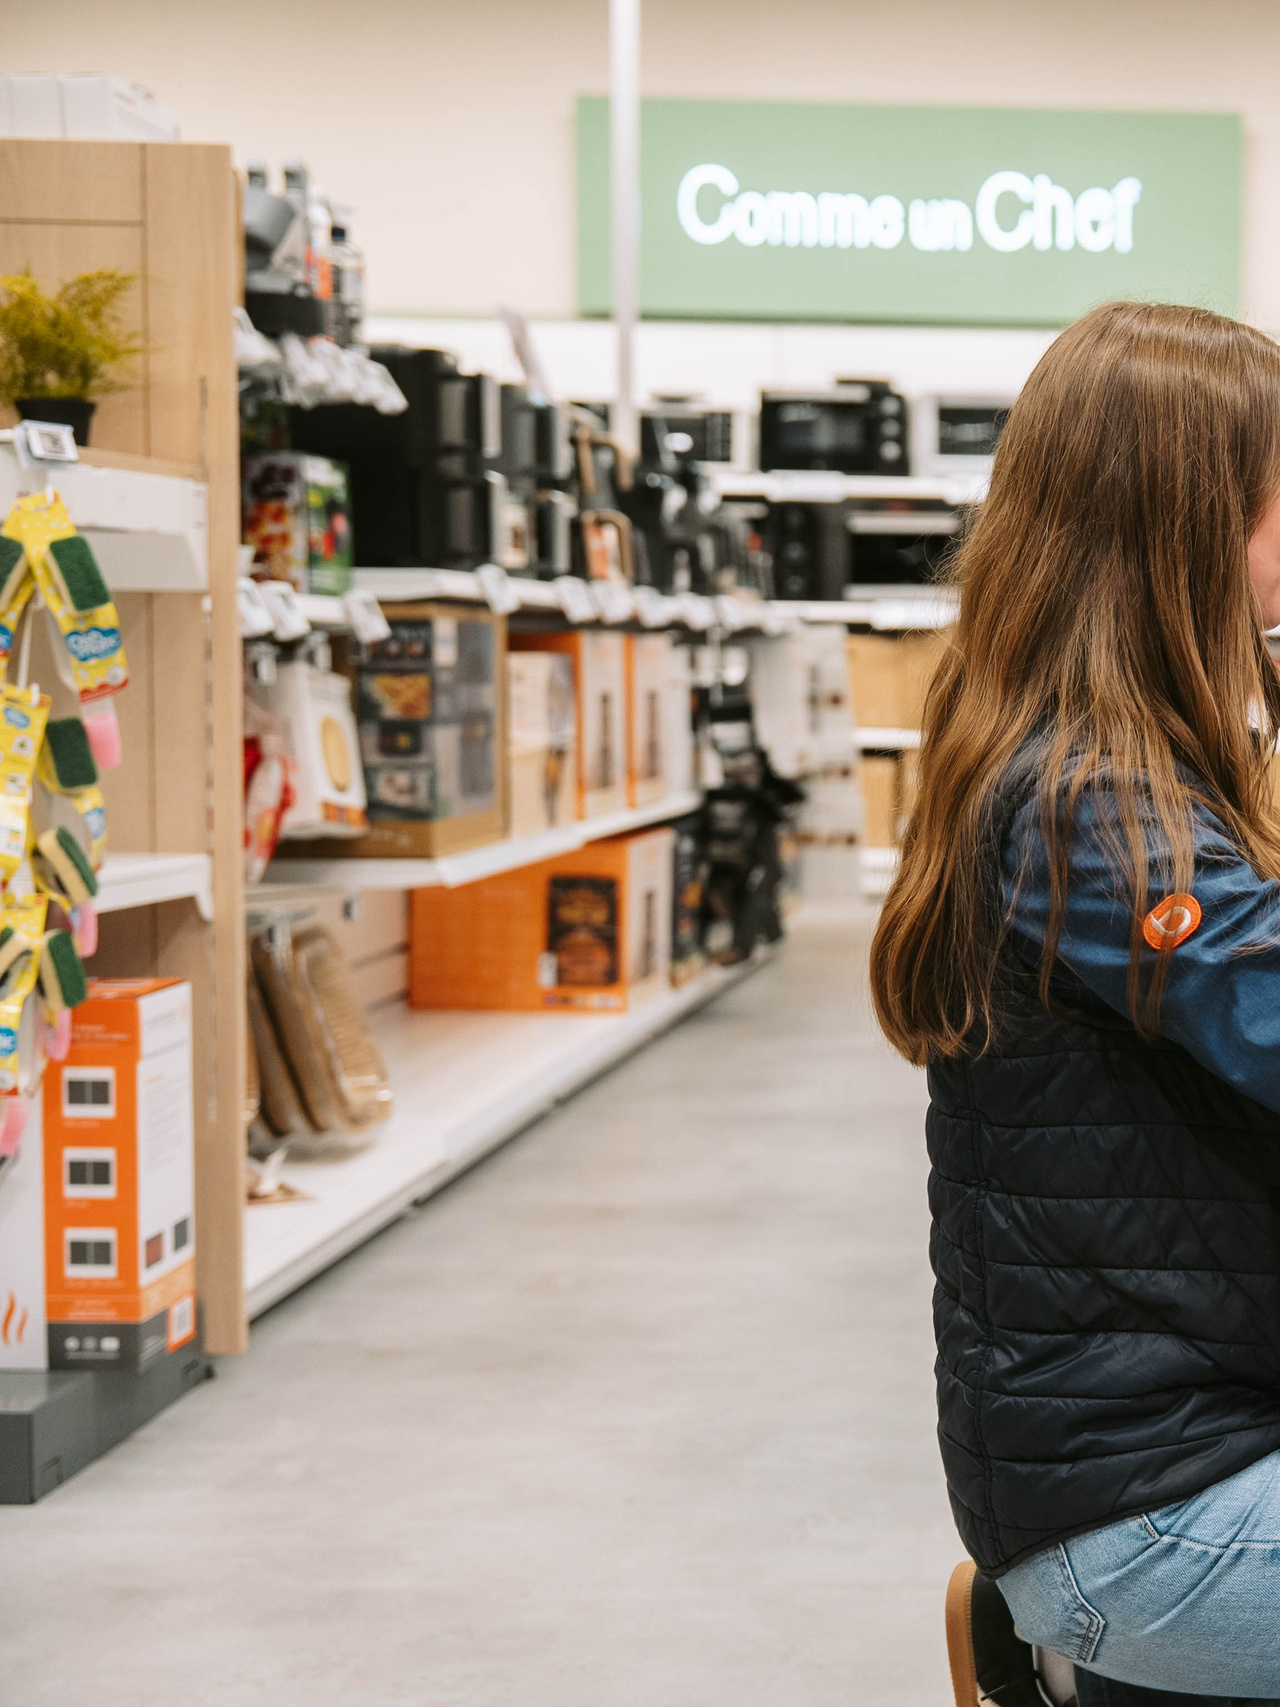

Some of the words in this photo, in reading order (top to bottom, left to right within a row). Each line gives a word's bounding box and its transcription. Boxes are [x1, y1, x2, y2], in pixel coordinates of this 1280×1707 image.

[677, 163, 905, 249] Comme
[907, 198, 973, 251] un
[975, 170, 1142, 254] Chef
